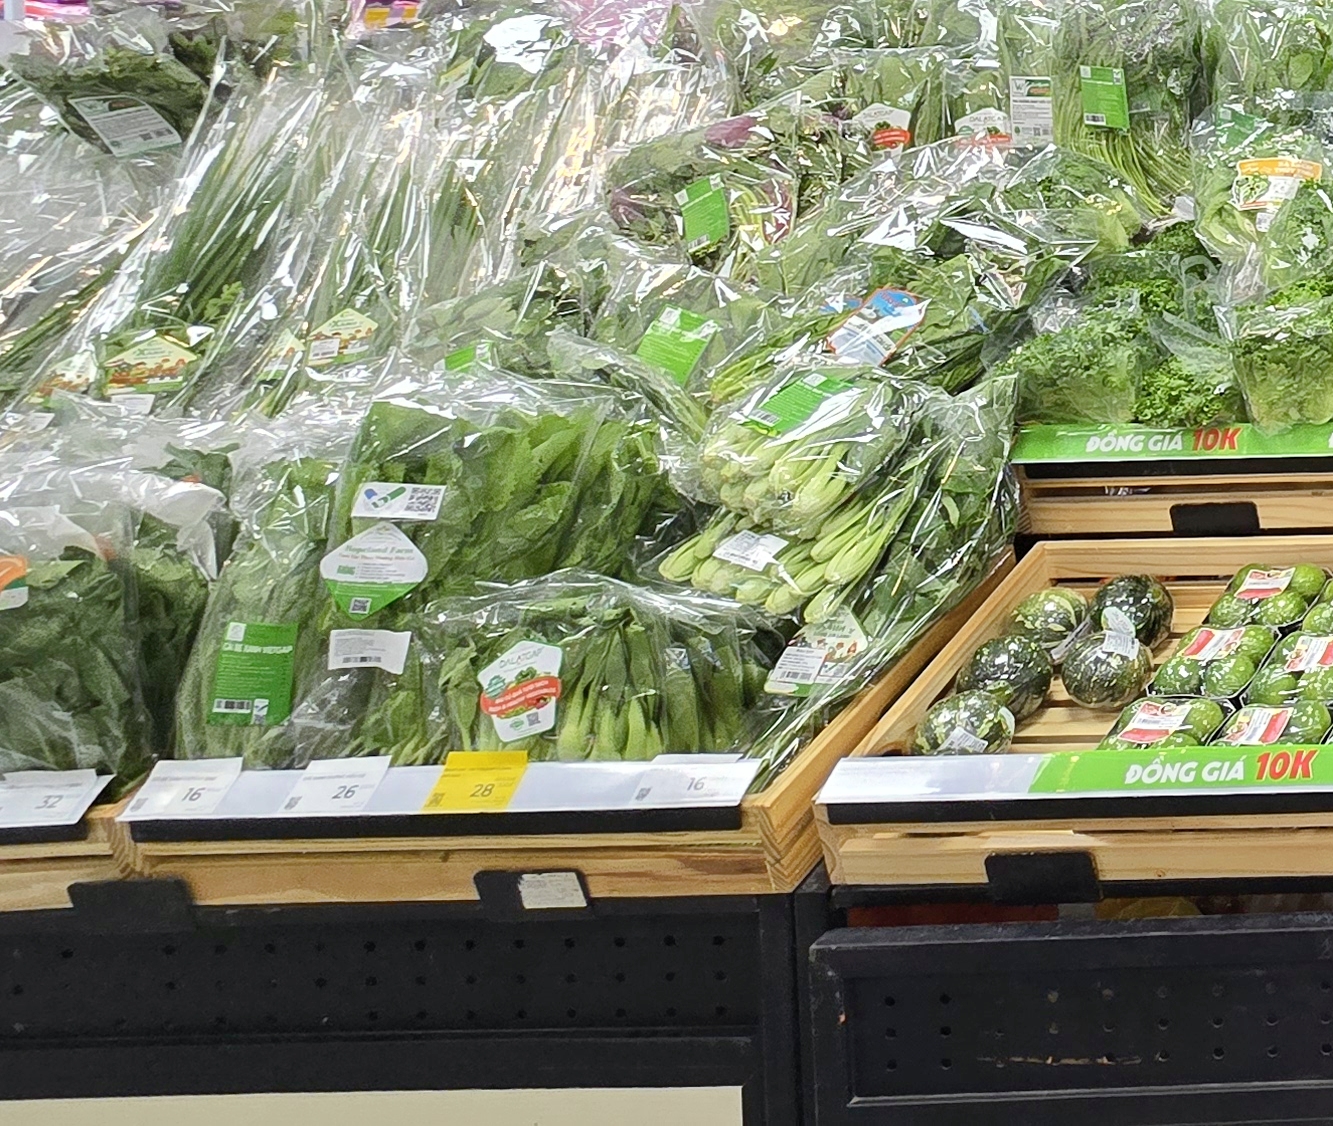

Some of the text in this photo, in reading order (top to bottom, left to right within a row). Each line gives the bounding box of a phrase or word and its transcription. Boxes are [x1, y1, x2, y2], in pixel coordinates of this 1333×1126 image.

[1086, 428, 1242, 453] ĐỒNG GIÁ 10K
[1125, 748, 1314, 785] ĐỒNG GIÁ 10K
[332, 783, 356, 800] 26
[470, 782, 494, 799] 28
[687, 777, 705, 792] 16
[34, 794, 57, 810] 32
[181, 787, 202, 802] 16
